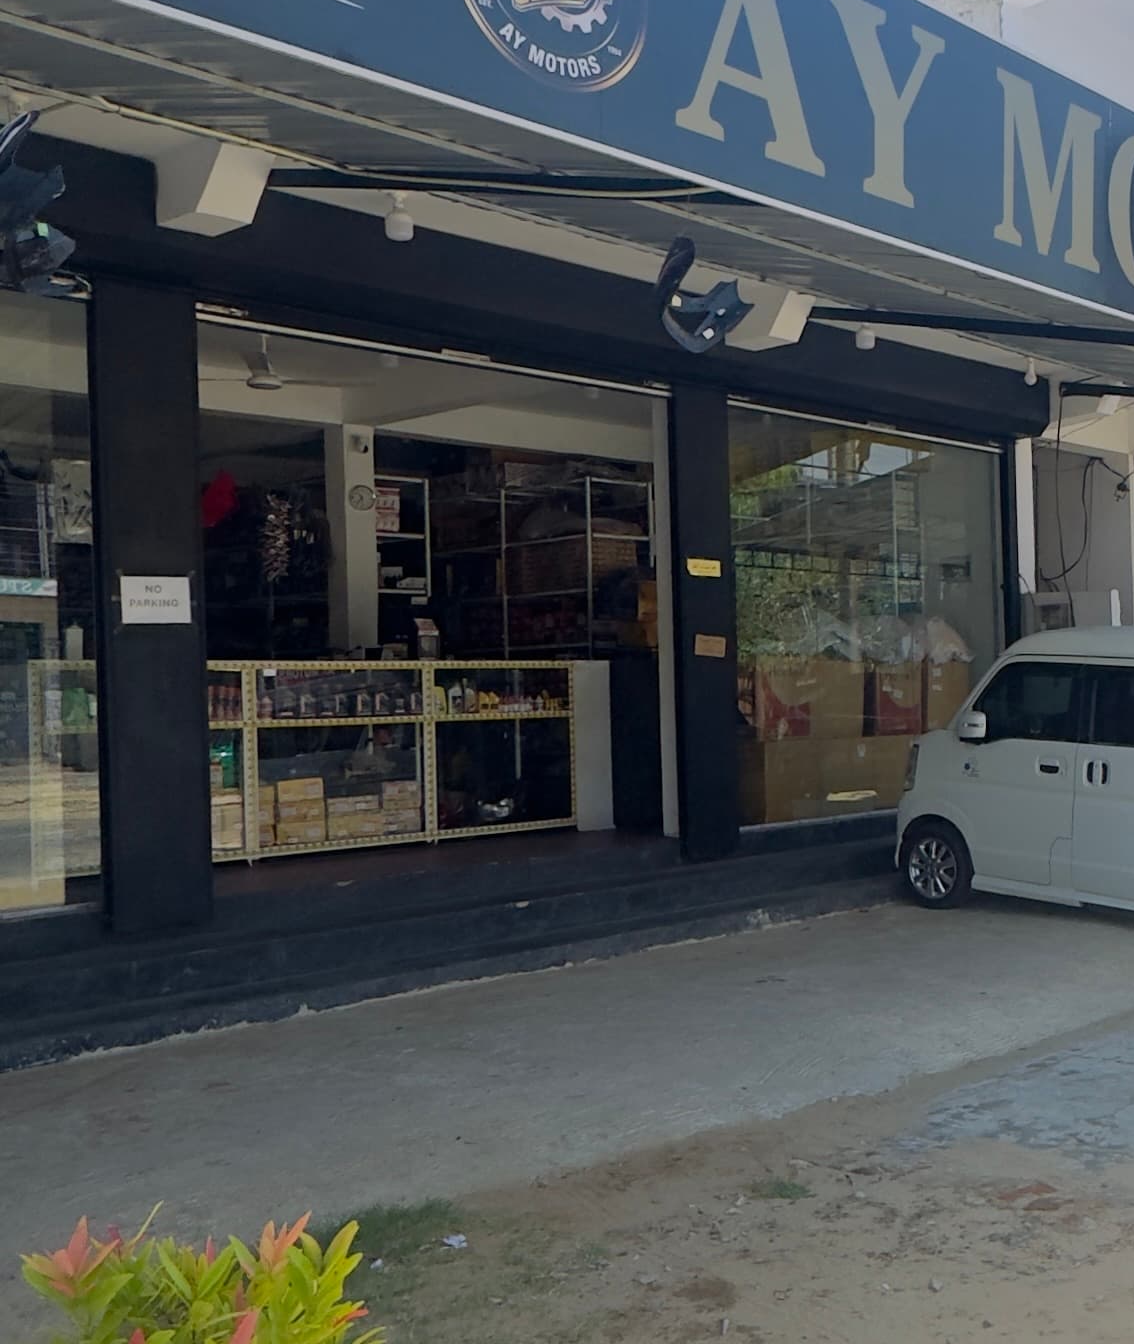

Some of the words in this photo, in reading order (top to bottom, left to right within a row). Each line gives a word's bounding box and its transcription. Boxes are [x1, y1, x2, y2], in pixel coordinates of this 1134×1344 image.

[499, 23, 526, 49] AY
[528, 44, 601, 78] MOTORS
[145, 584, 163, 594] NO
[129, 598, 180, 608] PARKING
